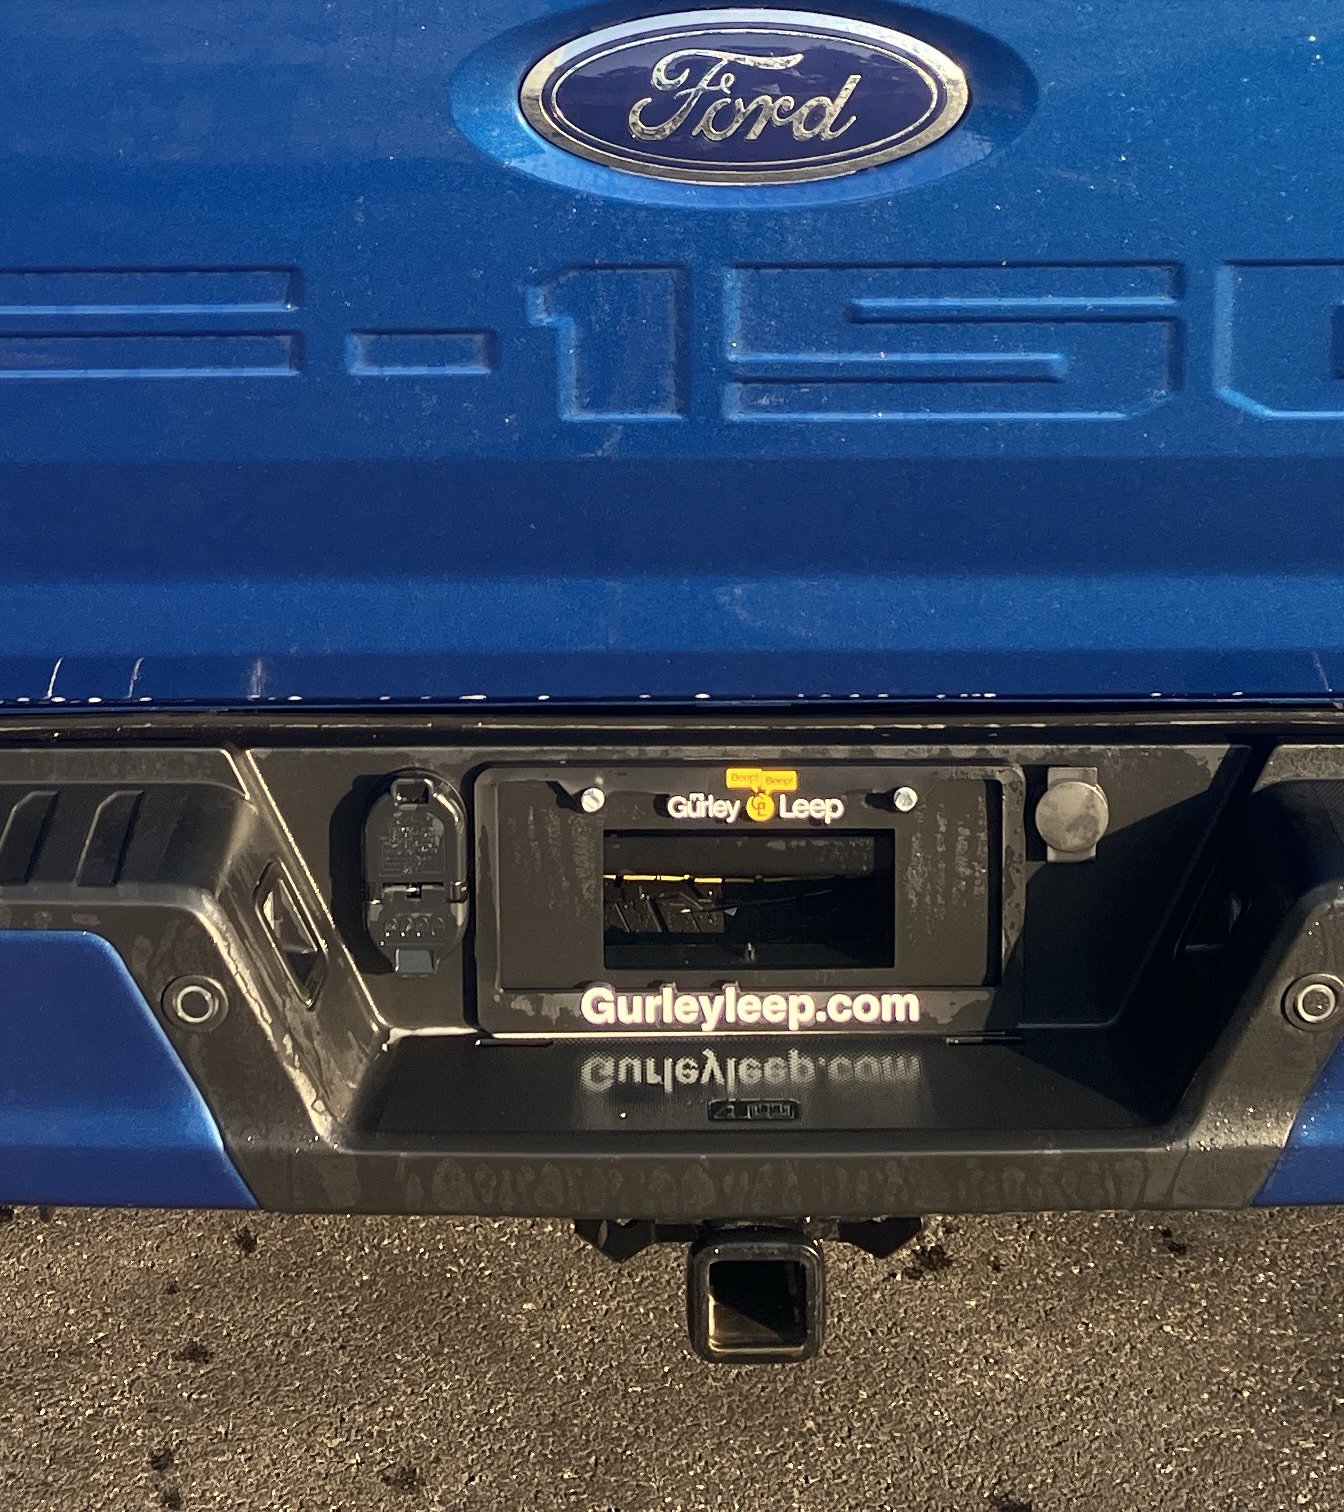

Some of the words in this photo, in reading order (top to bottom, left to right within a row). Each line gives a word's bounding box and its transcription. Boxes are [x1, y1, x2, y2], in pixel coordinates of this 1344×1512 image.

[626, 48, 862, 144] Ford
[779, 793, 846, 825] Leep
[580, 985, 921, 1032] Gurleyleep.com
